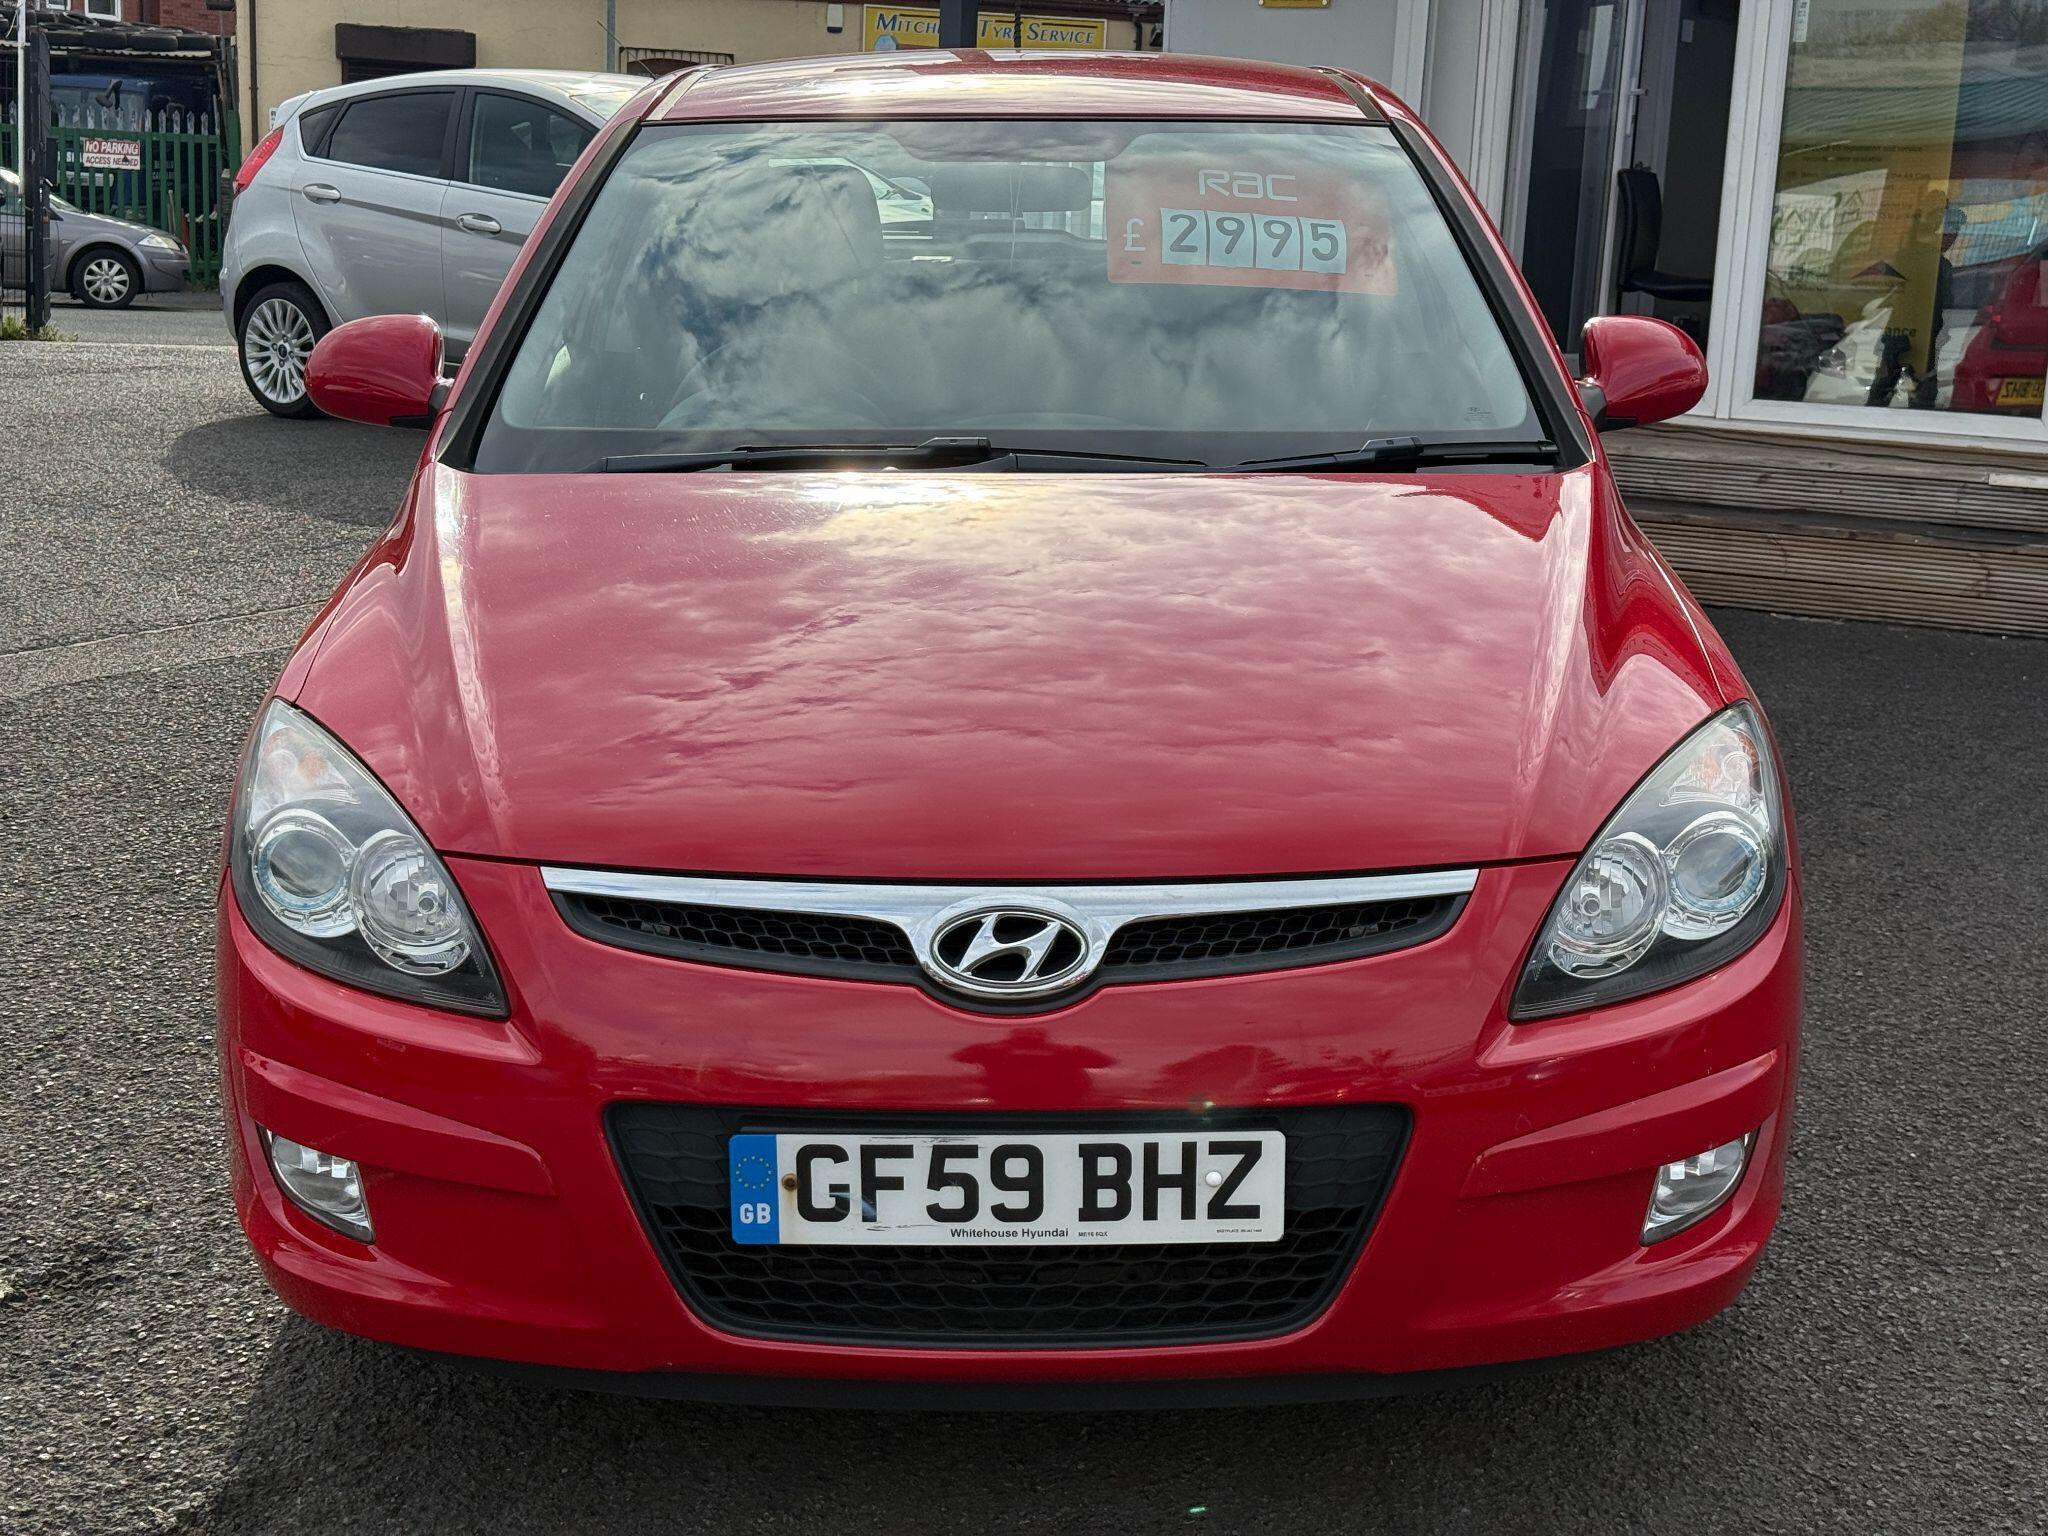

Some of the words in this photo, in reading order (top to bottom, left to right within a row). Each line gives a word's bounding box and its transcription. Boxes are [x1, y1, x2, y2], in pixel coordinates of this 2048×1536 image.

[876, 13, 941, 34] MITCH
[980, 20, 1015, 38] TYR
[1026, 22, 1095, 45] SERVICE
[85, 140, 99, 153] NO
[100, 141, 139, 155] PARKING
[85, 155, 111, 165] ACCESS
[1123, 217, 1146, 252] £
[1168, 213, 1340, 262] 2995
[795, 1142, 1045, 1223] GF59
[1078, 1140, 1263, 1222] BHZ
[739, 1202, 772, 1225] GB
[949, 1227, 1019, 1239] Whitehouse
[1021, 1228, 1069, 1239] Hyundai
